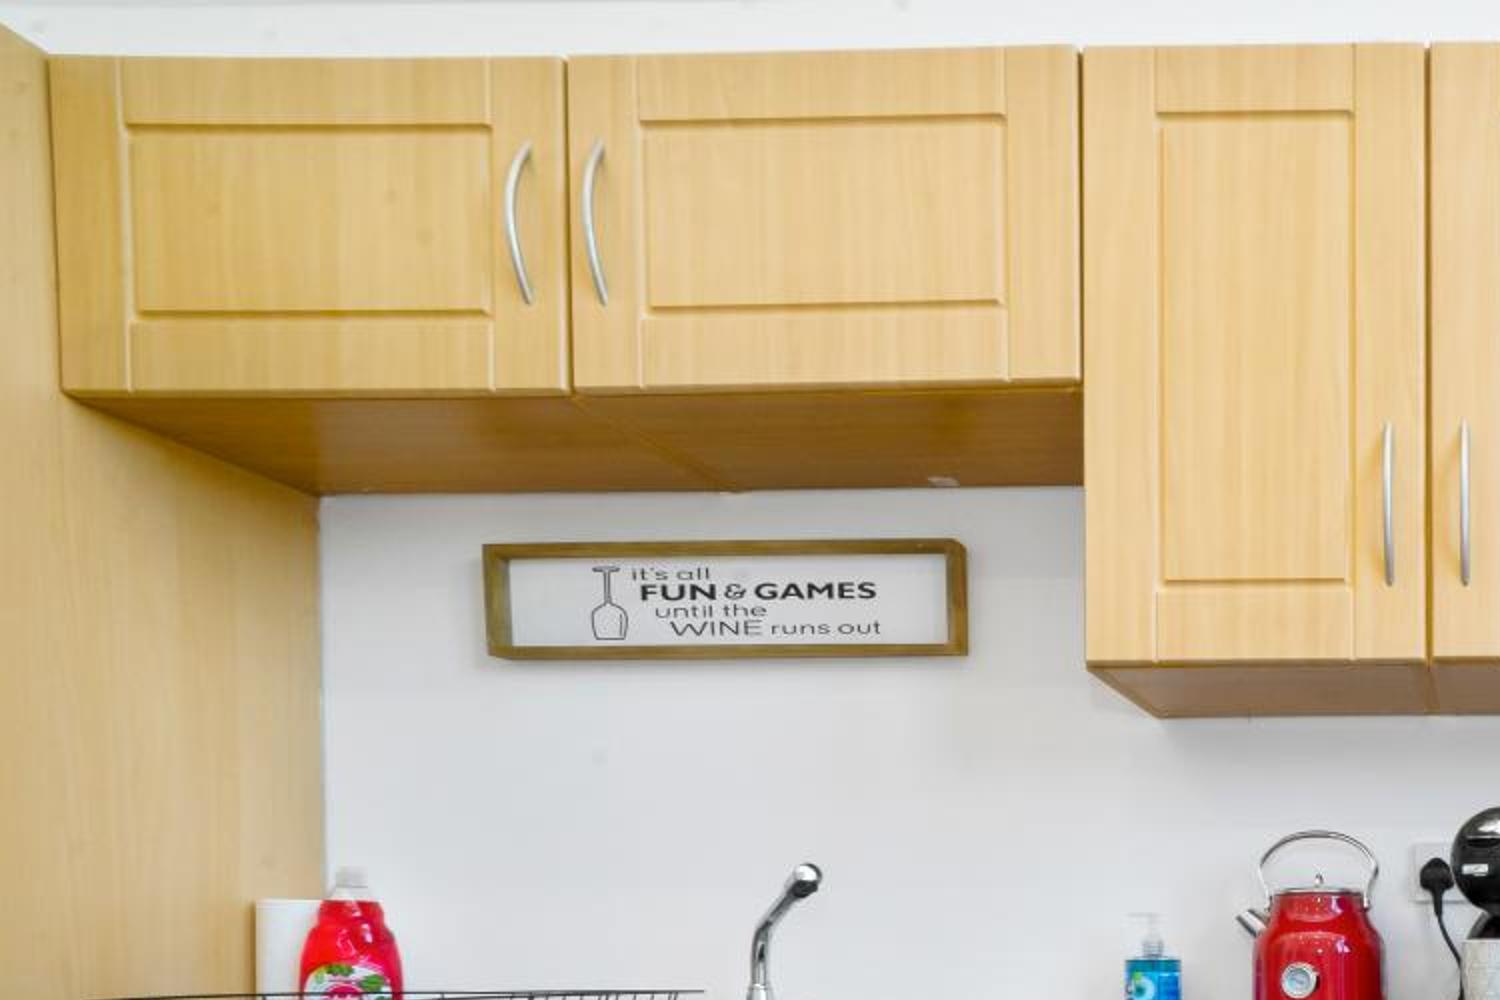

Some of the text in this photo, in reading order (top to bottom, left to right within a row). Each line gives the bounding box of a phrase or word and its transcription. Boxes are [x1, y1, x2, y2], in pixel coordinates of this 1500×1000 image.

[632, 567, 710, 580] it's all
[641, 582, 877, 601] FUN & GAMES
[655, 604, 767, 619] until the
[669, 619, 881, 636] WINE runs out
